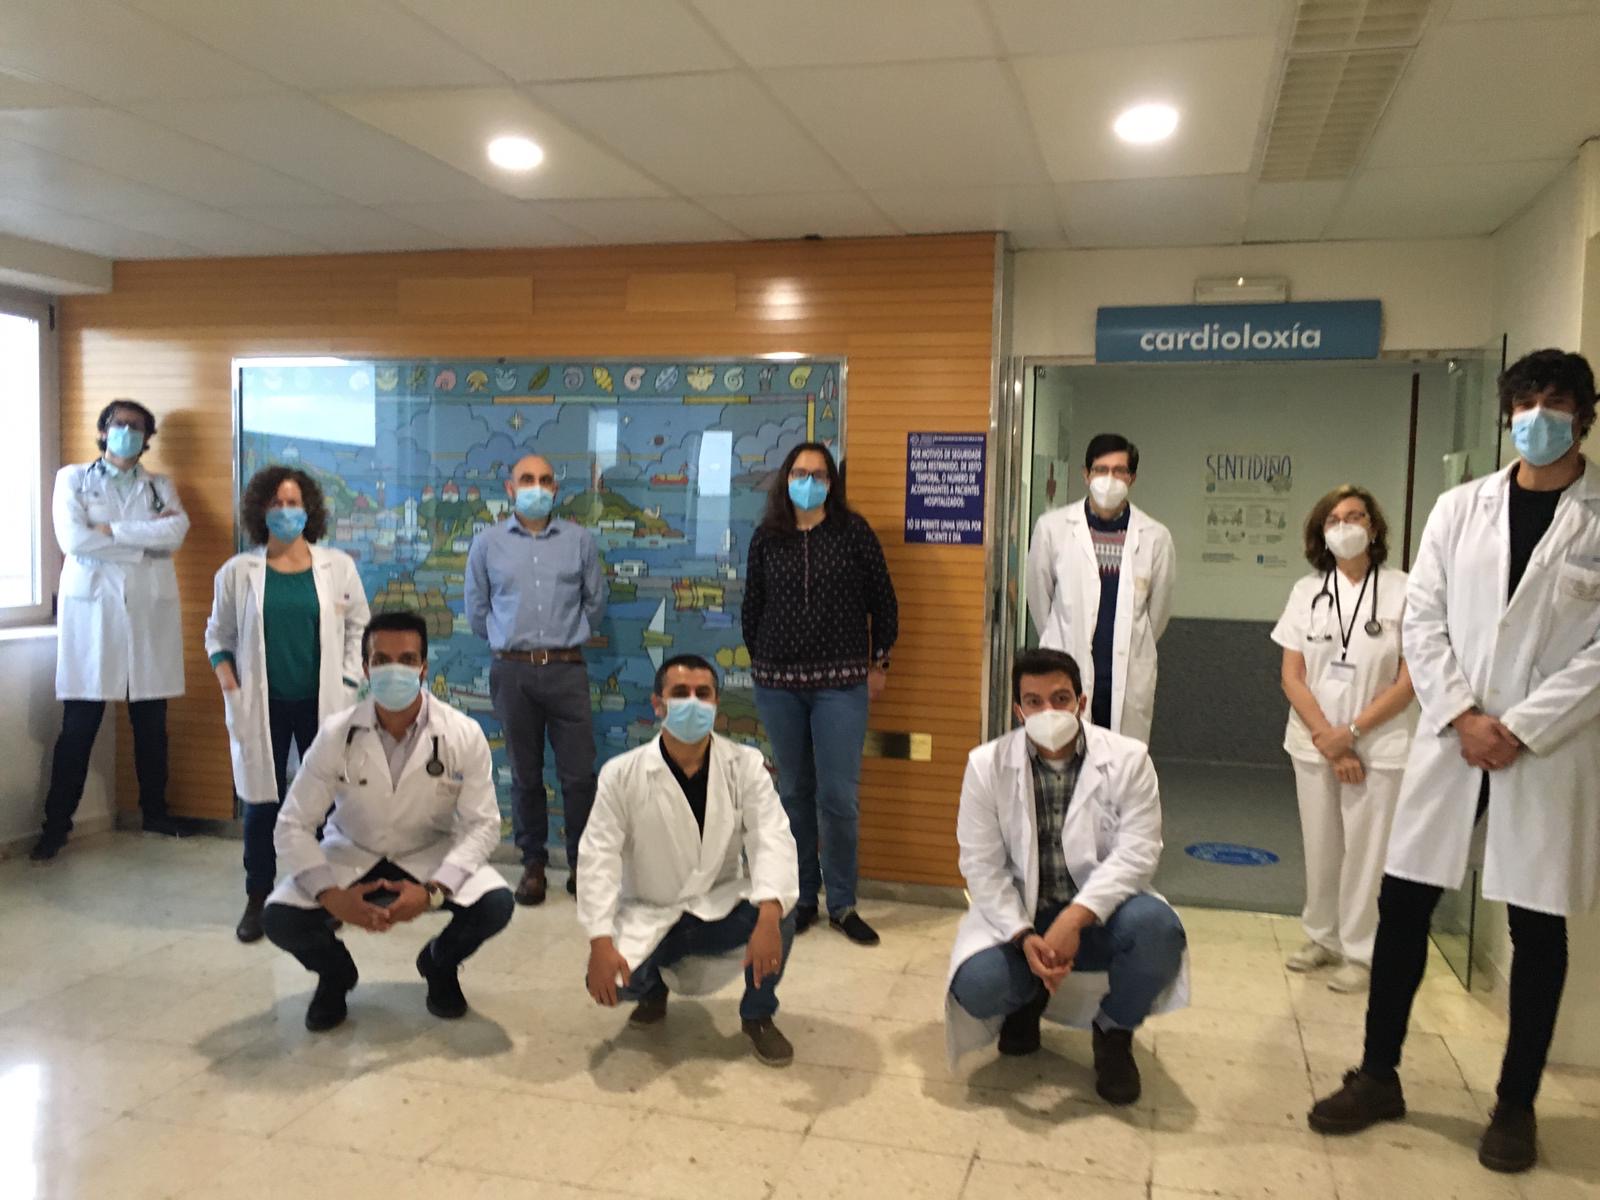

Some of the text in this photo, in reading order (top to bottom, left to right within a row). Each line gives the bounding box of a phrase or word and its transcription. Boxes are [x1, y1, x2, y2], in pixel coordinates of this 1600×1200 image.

[1140, 322, 1321, 351] cardioloxía
[911, 448, 982, 461] POR MOTIVOS DE SEGURIDADE
[960, 460, 967, 472] DE
[942, 472, 947, 484] O
[969, 472, 976, 484] DE
